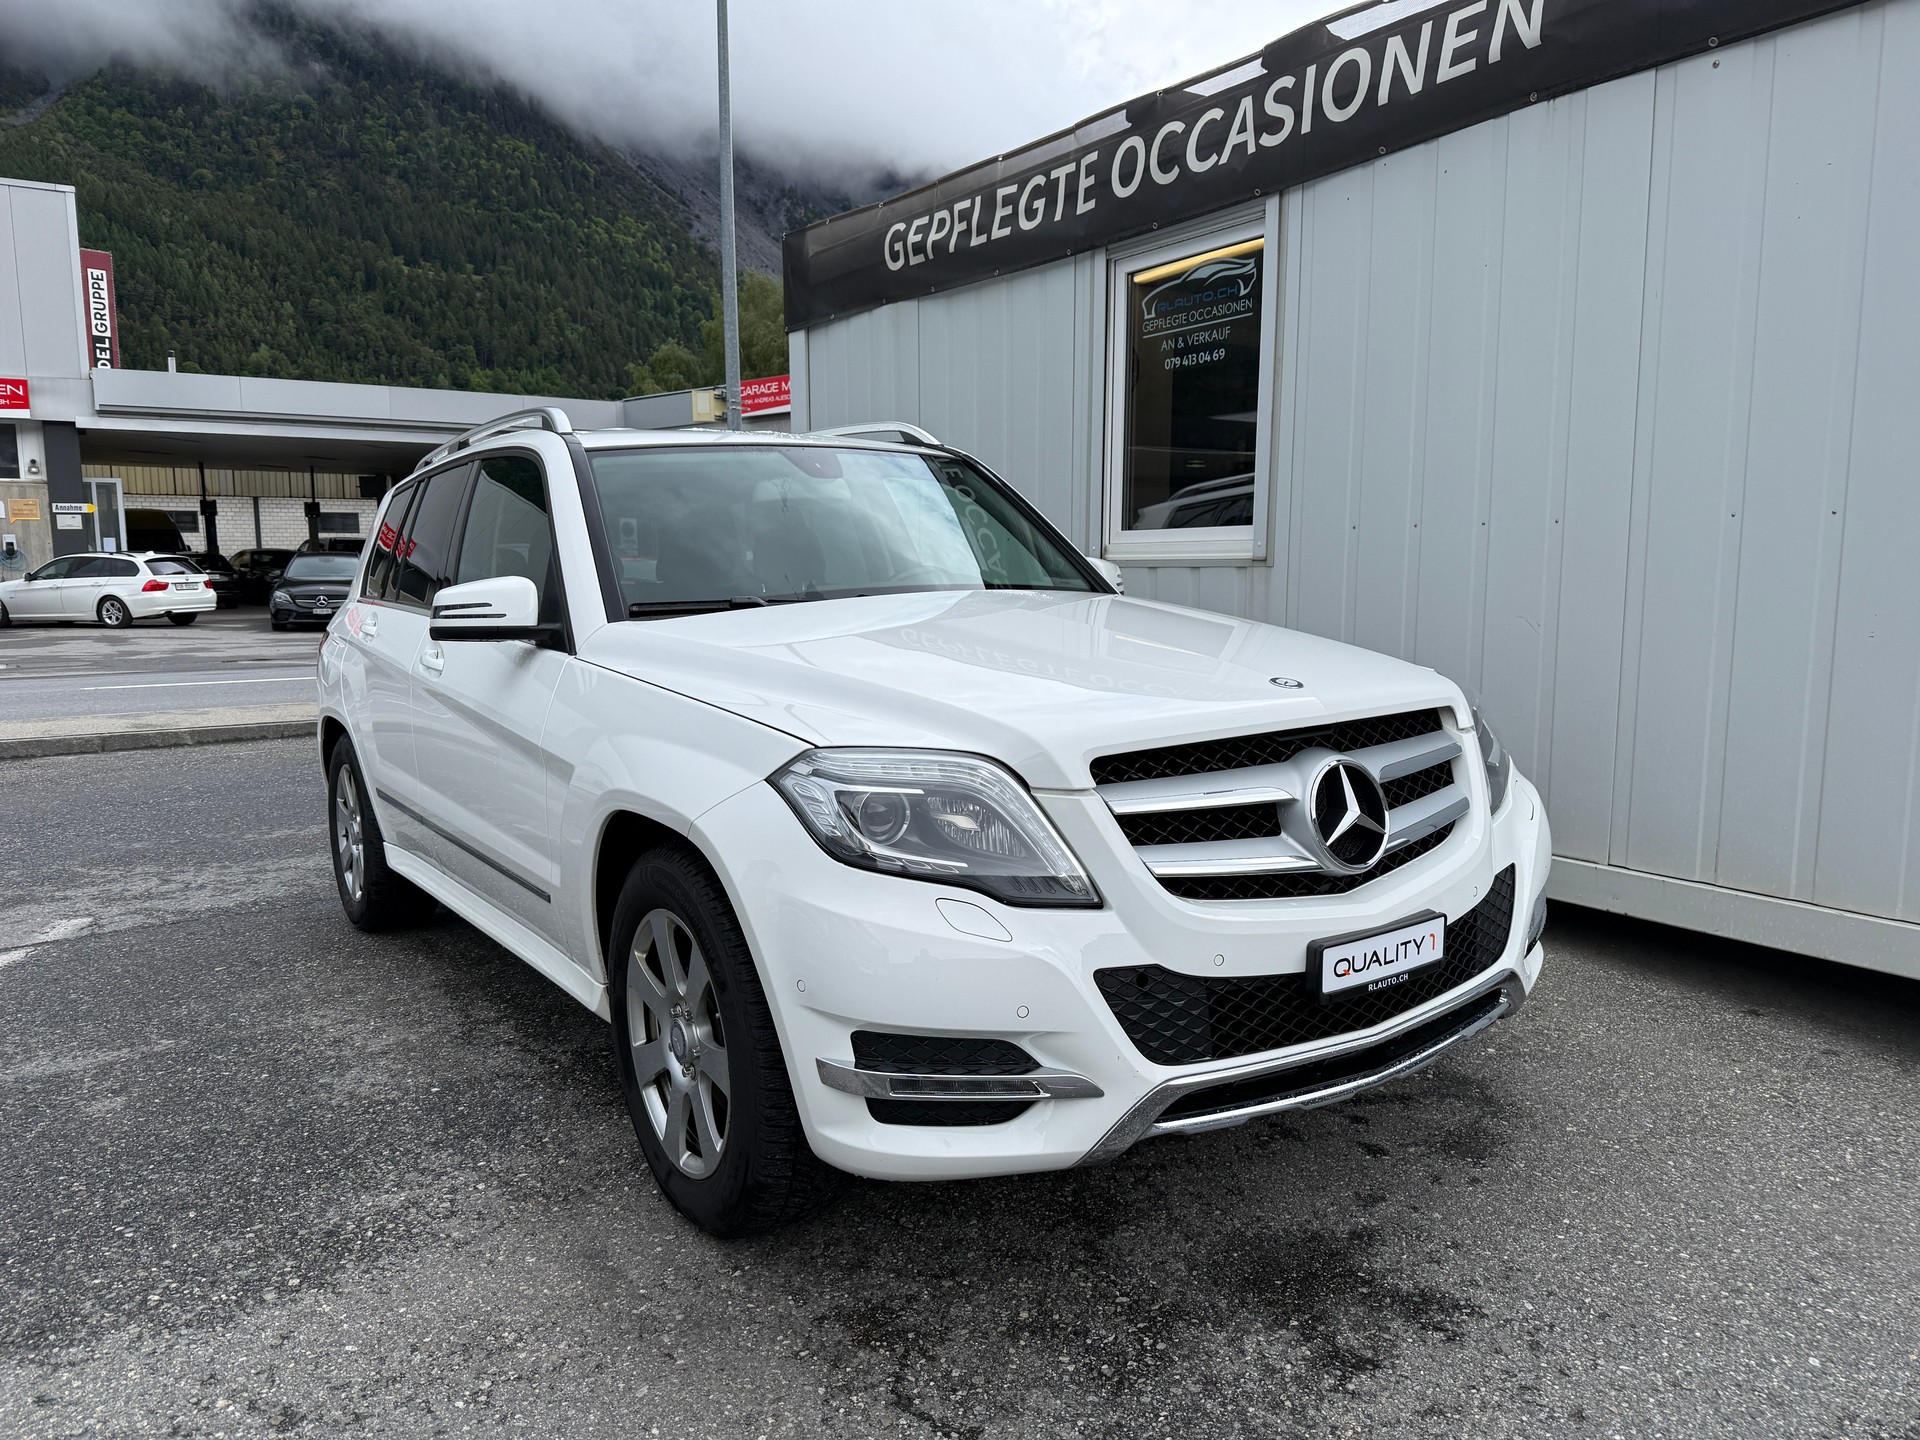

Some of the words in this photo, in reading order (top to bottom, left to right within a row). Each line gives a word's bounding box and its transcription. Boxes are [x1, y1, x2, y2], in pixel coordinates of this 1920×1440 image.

[884, 151, 1098, 271] GEPFLEGTE
[1111, 0, 1545, 198] OCCASIONEN
[91, 271, 108, 333] GRUPPE
[1158, 284, 1238, 312] RLAUTO.CH
[1143, 313, 1187, 332] GEPFLEGTE
[1189, 298, 1253, 321] OCCASIONEN
[1161, 338, 1175, 351] AN
[1177, 337, 1185, 348] &
[1187, 326, 1231, 346] VERKAUF
[1164, 357, 1181, 369] 079
[1182, 354, 1197, 366] 413
[1198, 351, 1211, 363] 04
[1213, 348, 1225, 360] 69
[55, 504, 83, 512] Annahme
[1334, 936, 1425, 978] QUALITY
[1368, 973, 1409, 991] RLAUTO.CH
